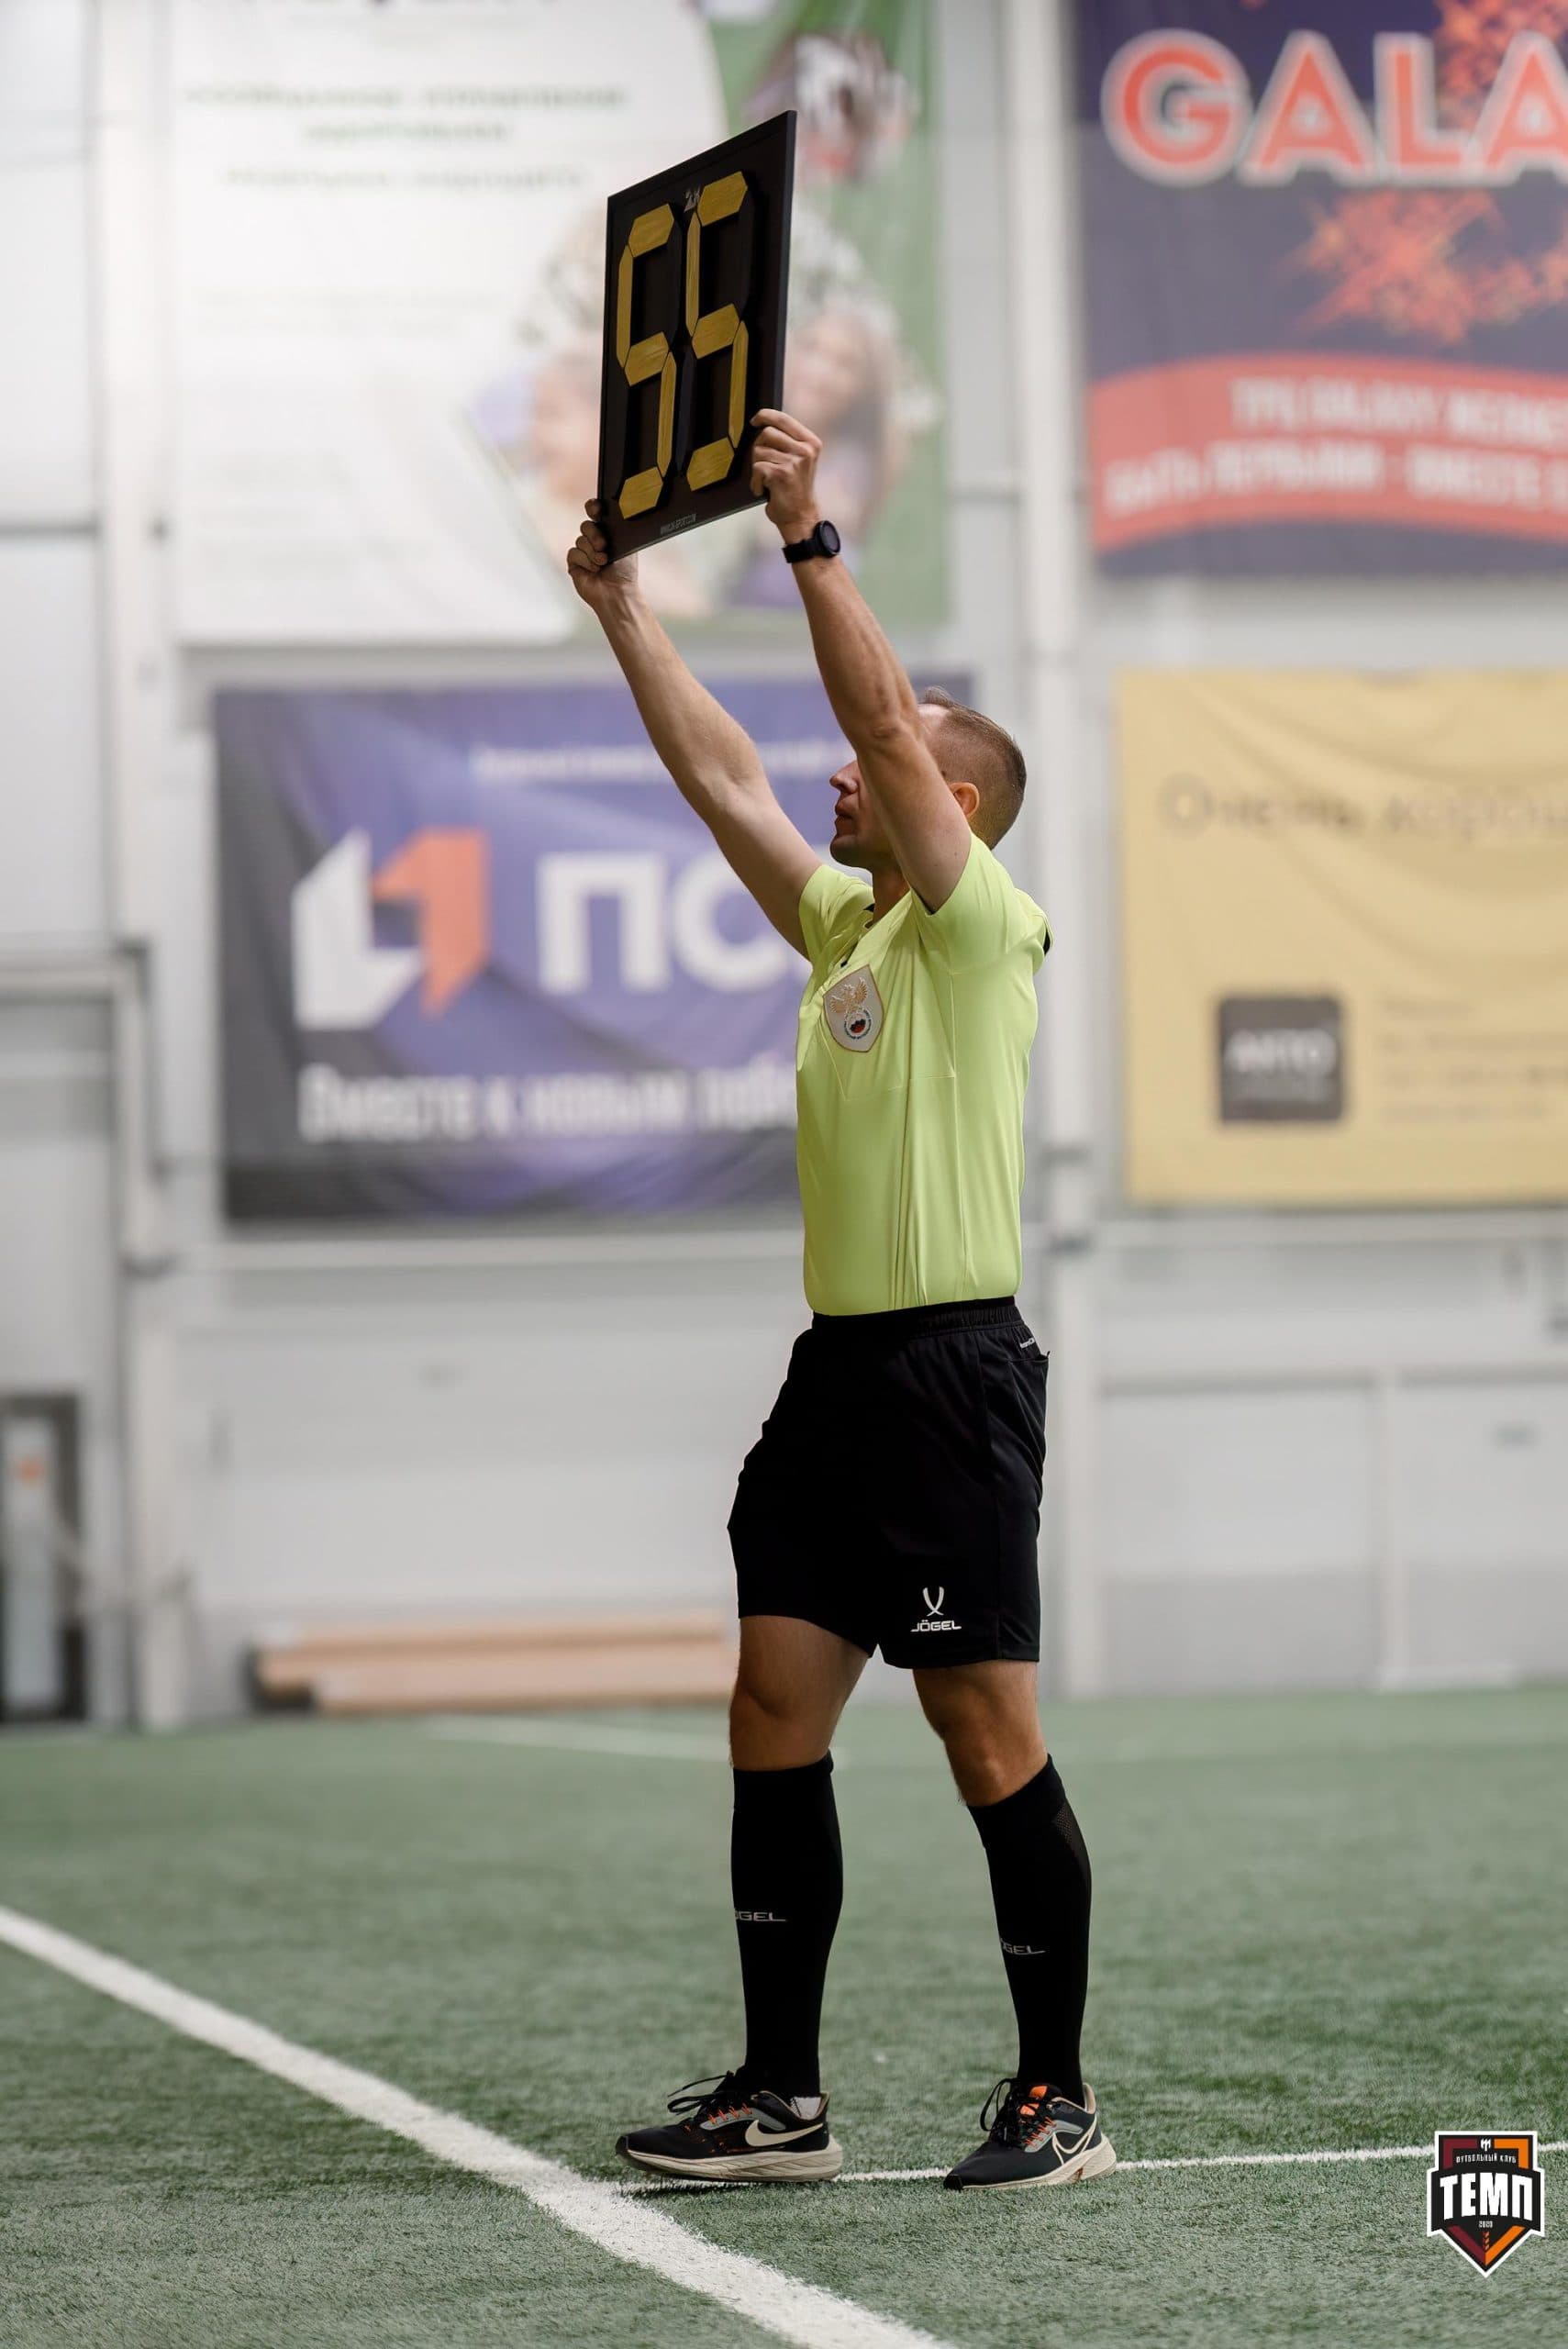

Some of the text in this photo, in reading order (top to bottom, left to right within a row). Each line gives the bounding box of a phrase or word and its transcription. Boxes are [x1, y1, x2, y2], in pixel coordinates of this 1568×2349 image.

[617, 171, 749, 519] 55
[539, 849, 807, 996] ПС
[910, 1620, 962, 1632] JÖGEL
